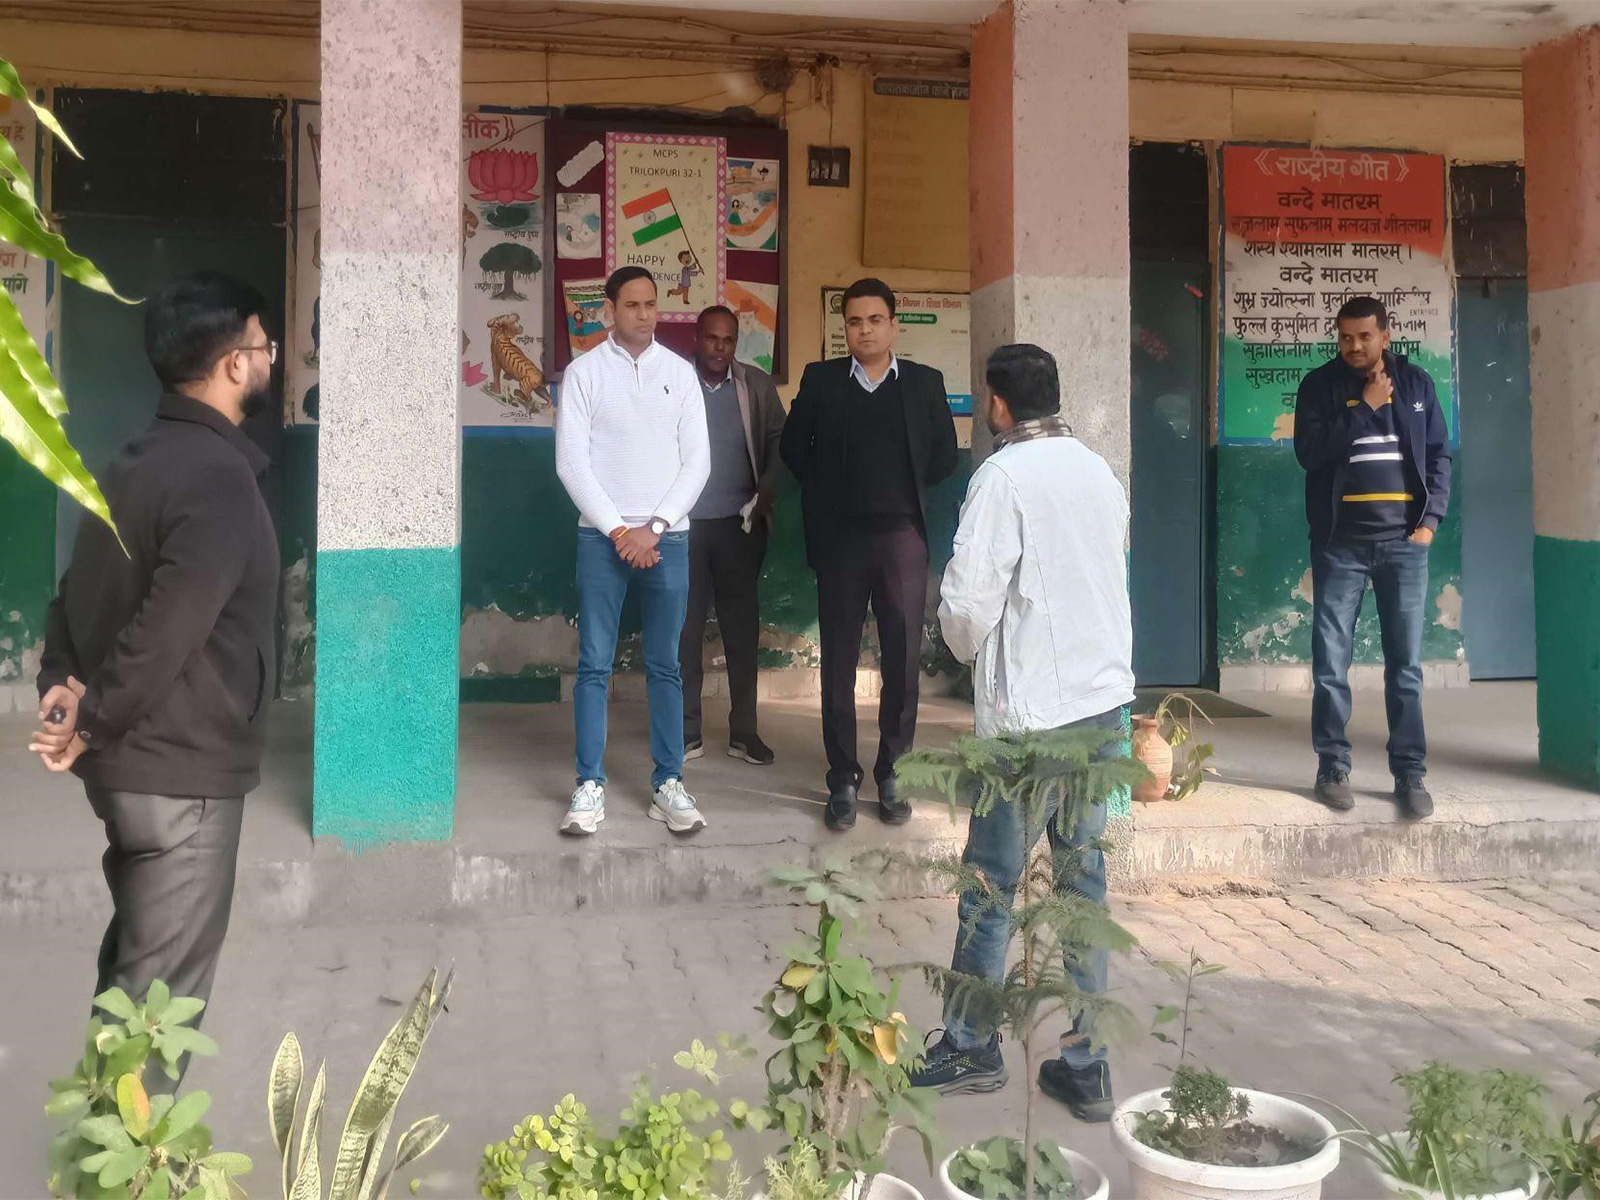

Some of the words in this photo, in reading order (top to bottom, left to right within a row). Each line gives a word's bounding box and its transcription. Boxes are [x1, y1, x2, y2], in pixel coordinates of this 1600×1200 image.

[653, 149, 679, 159] MCPS
[630, 166, 681, 177] TRILOKPURI
[683, 168, 702, 178] 32-1
[1276, 153, 1345, 182] राष्ट्रीय
[1351, 153, 1389, 181] गीत
[1277, 187, 1315, 211] वन्दे
[1321, 192, 1382, 214] मातरम्
[626, 254, 665, 267] HAPPY
[1351, 243, 1402, 264] मातरम्
[1280, 262, 1315, 284] वन्दे
[1321, 267, 1379, 287] मातरम्
[1271, 311, 1319, 340] कुसुमित
